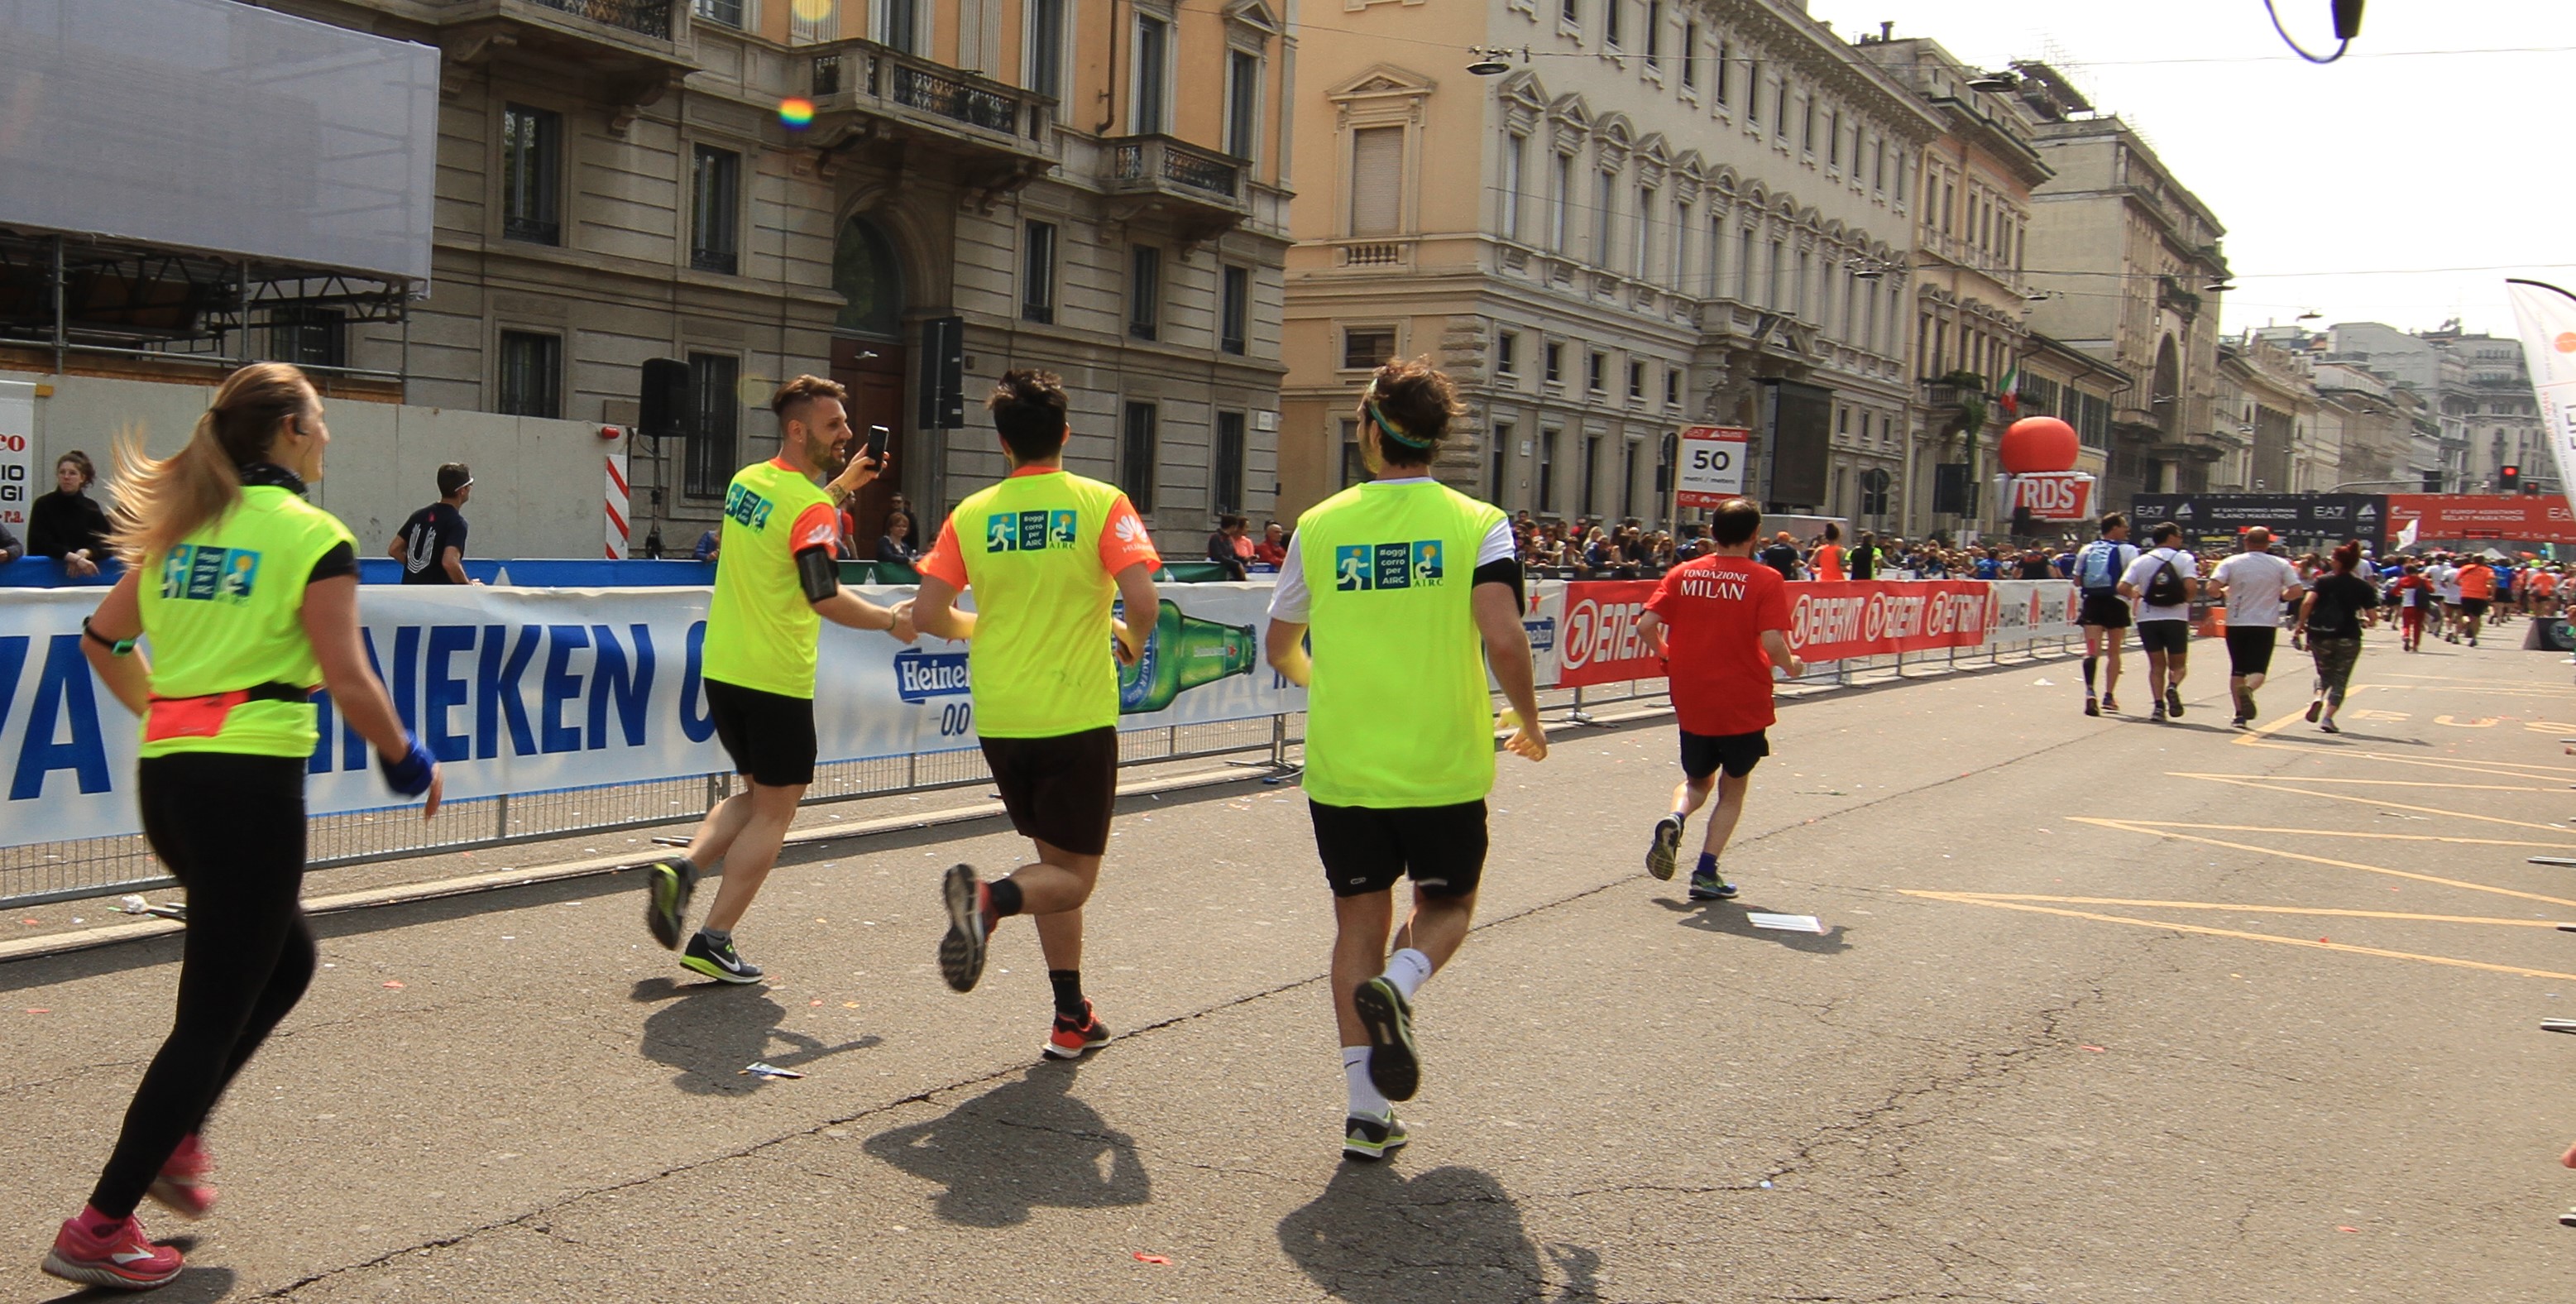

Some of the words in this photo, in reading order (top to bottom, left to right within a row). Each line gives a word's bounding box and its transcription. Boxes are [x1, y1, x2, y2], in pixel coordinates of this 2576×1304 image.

[1693, 450, 1731, 471] 50
[0, 485, 23, 501] GI
[2023, 478, 2076, 509] RDS
[2314, 506, 2346, 517] EA7
[2548, 507, 2573, 518] EA
[1049, 542, 1075, 550] AIRC
[1382, 576, 1405, 584] AIRC
[1683, 569, 1749, 582] FONDAZIONE
[1414, 578, 1444, 587] AIRC
[1680, 579, 1746, 601] MILAN
[941, 702, 970, 736] 0.0
